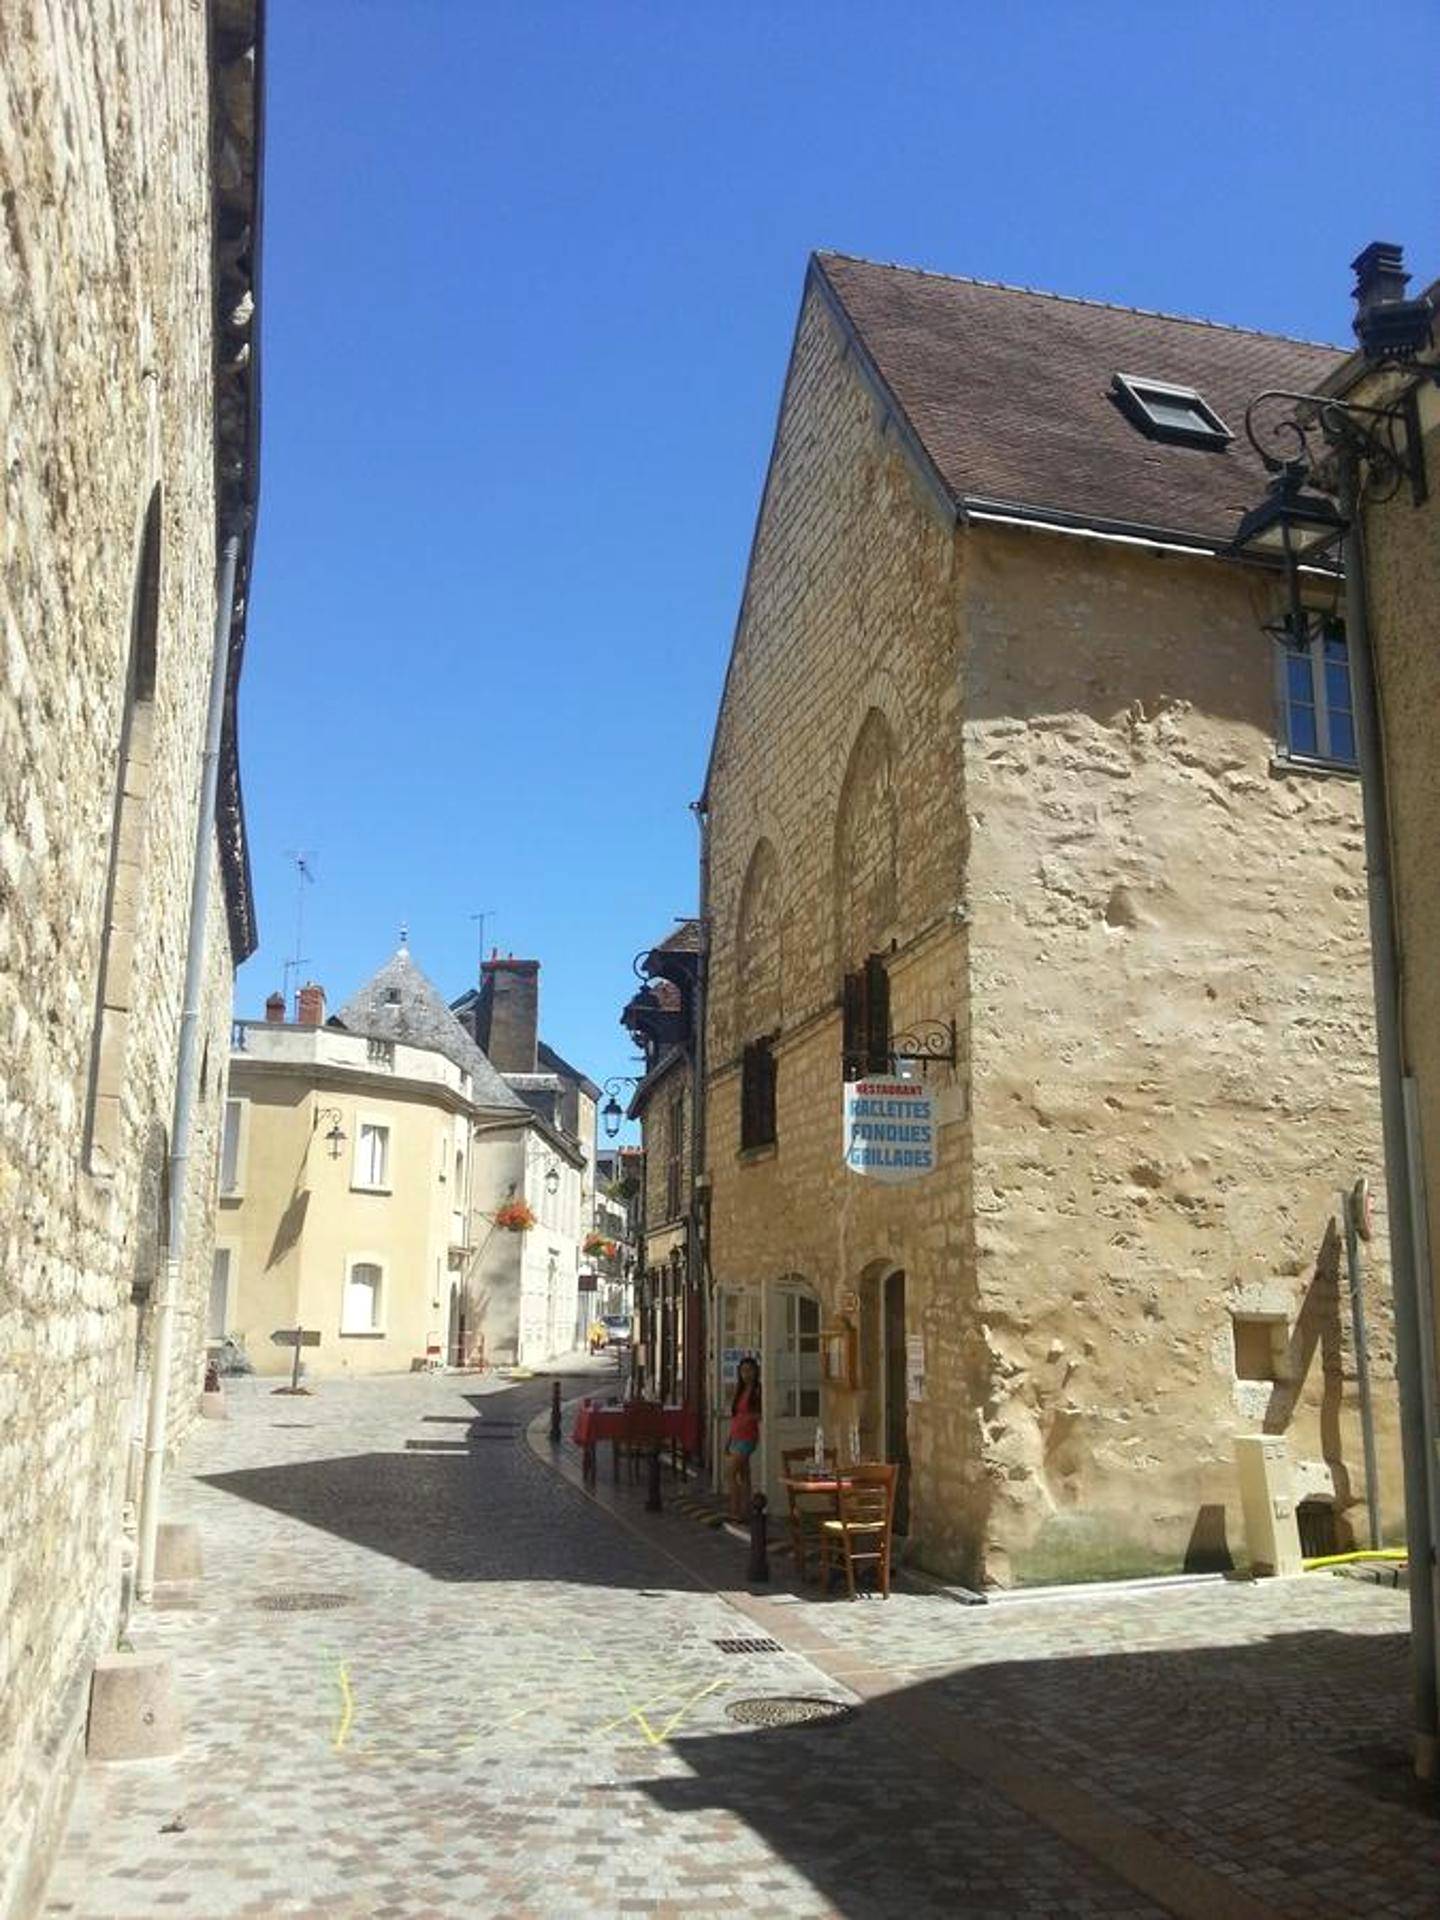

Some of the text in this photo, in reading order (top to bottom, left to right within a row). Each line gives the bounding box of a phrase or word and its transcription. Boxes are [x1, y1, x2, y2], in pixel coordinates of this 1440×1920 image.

[855, 1083, 922, 1095] RESTAURANT
[850, 1100, 930, 1118] RACLETTES
[851, 1124, 931, 1142] FONDUES
[850, 1148, 931, 1167] GRILLADES
